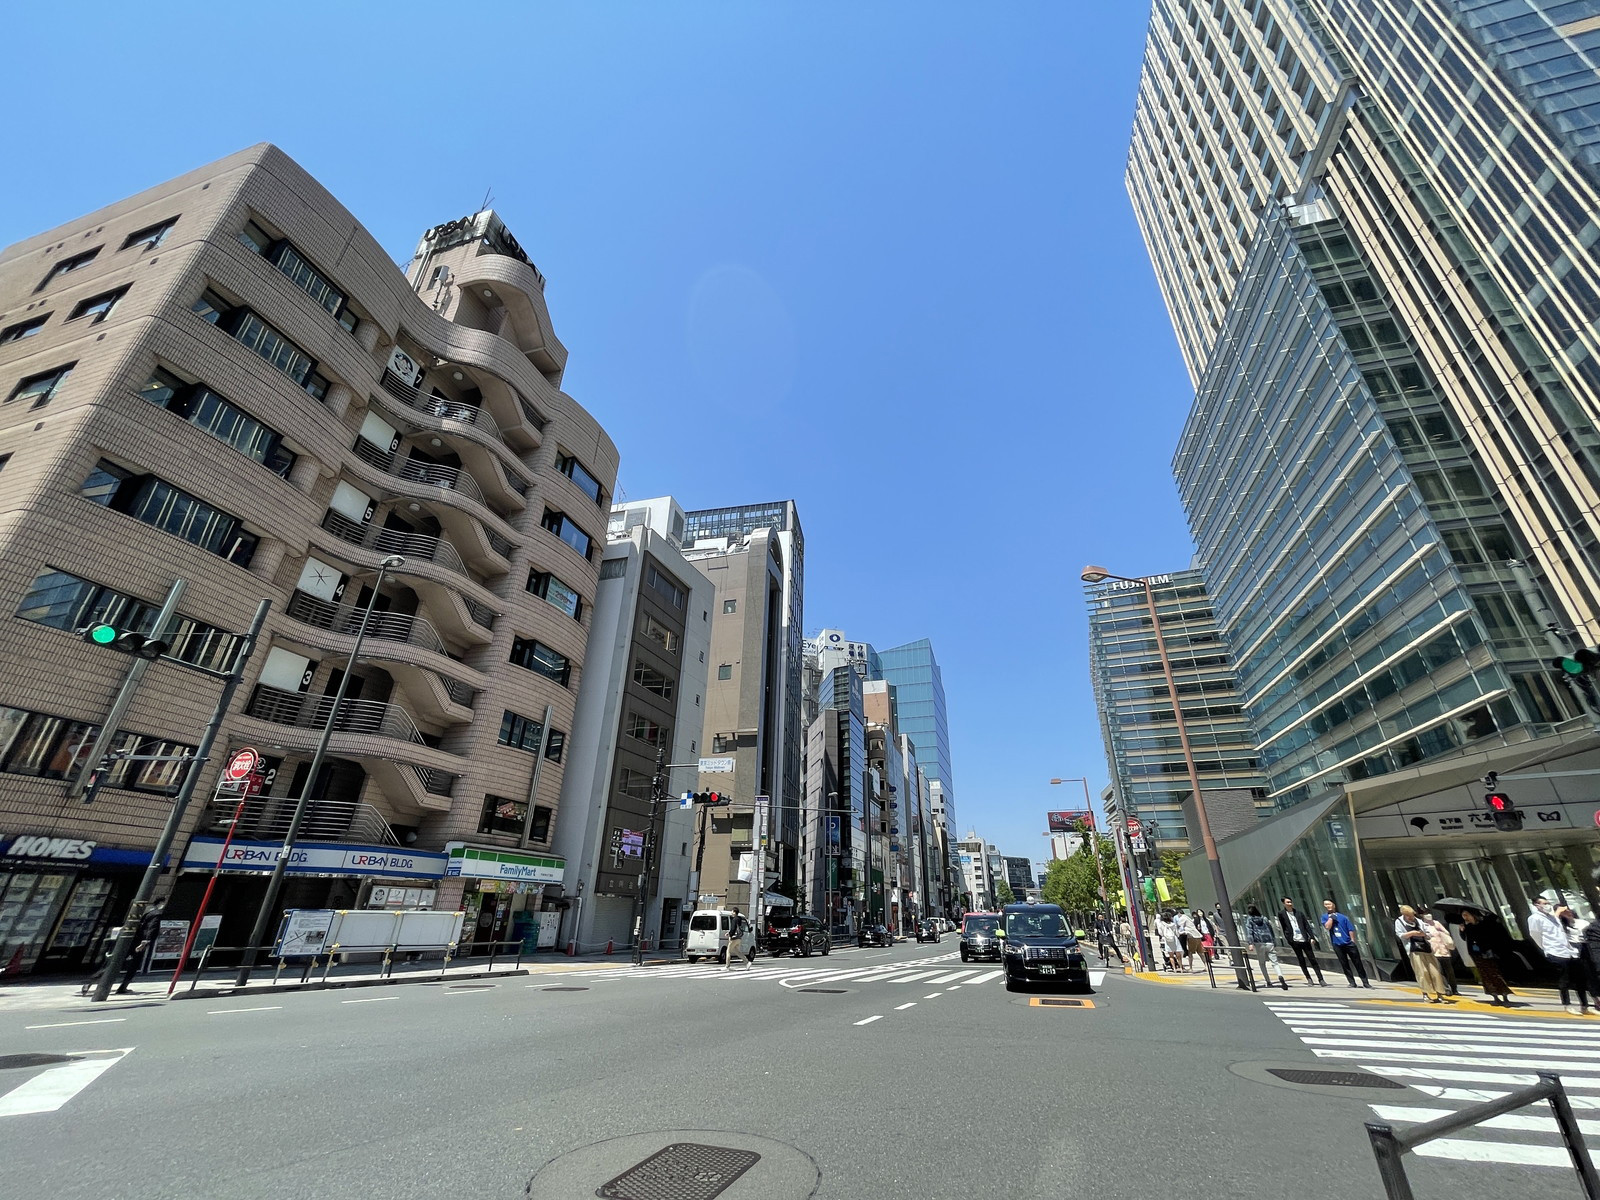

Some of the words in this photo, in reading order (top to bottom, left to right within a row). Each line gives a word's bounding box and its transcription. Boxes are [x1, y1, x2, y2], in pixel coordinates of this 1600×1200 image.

[415, 372, 423, 384] 7
[391, 439, 399, 450] 6
[365, 507, 373, 519] 5
[335, 584, 345, 597] 4
[303, 670, 313, 684] 3
[265, 768, 276, 785] 2
[6, 835, 97, 860] HOMES
[225, 849, 272, 861] URBAN
[352, 854, 389, 867] URBAN
[500, 864, 537, 877] FamilyMart
